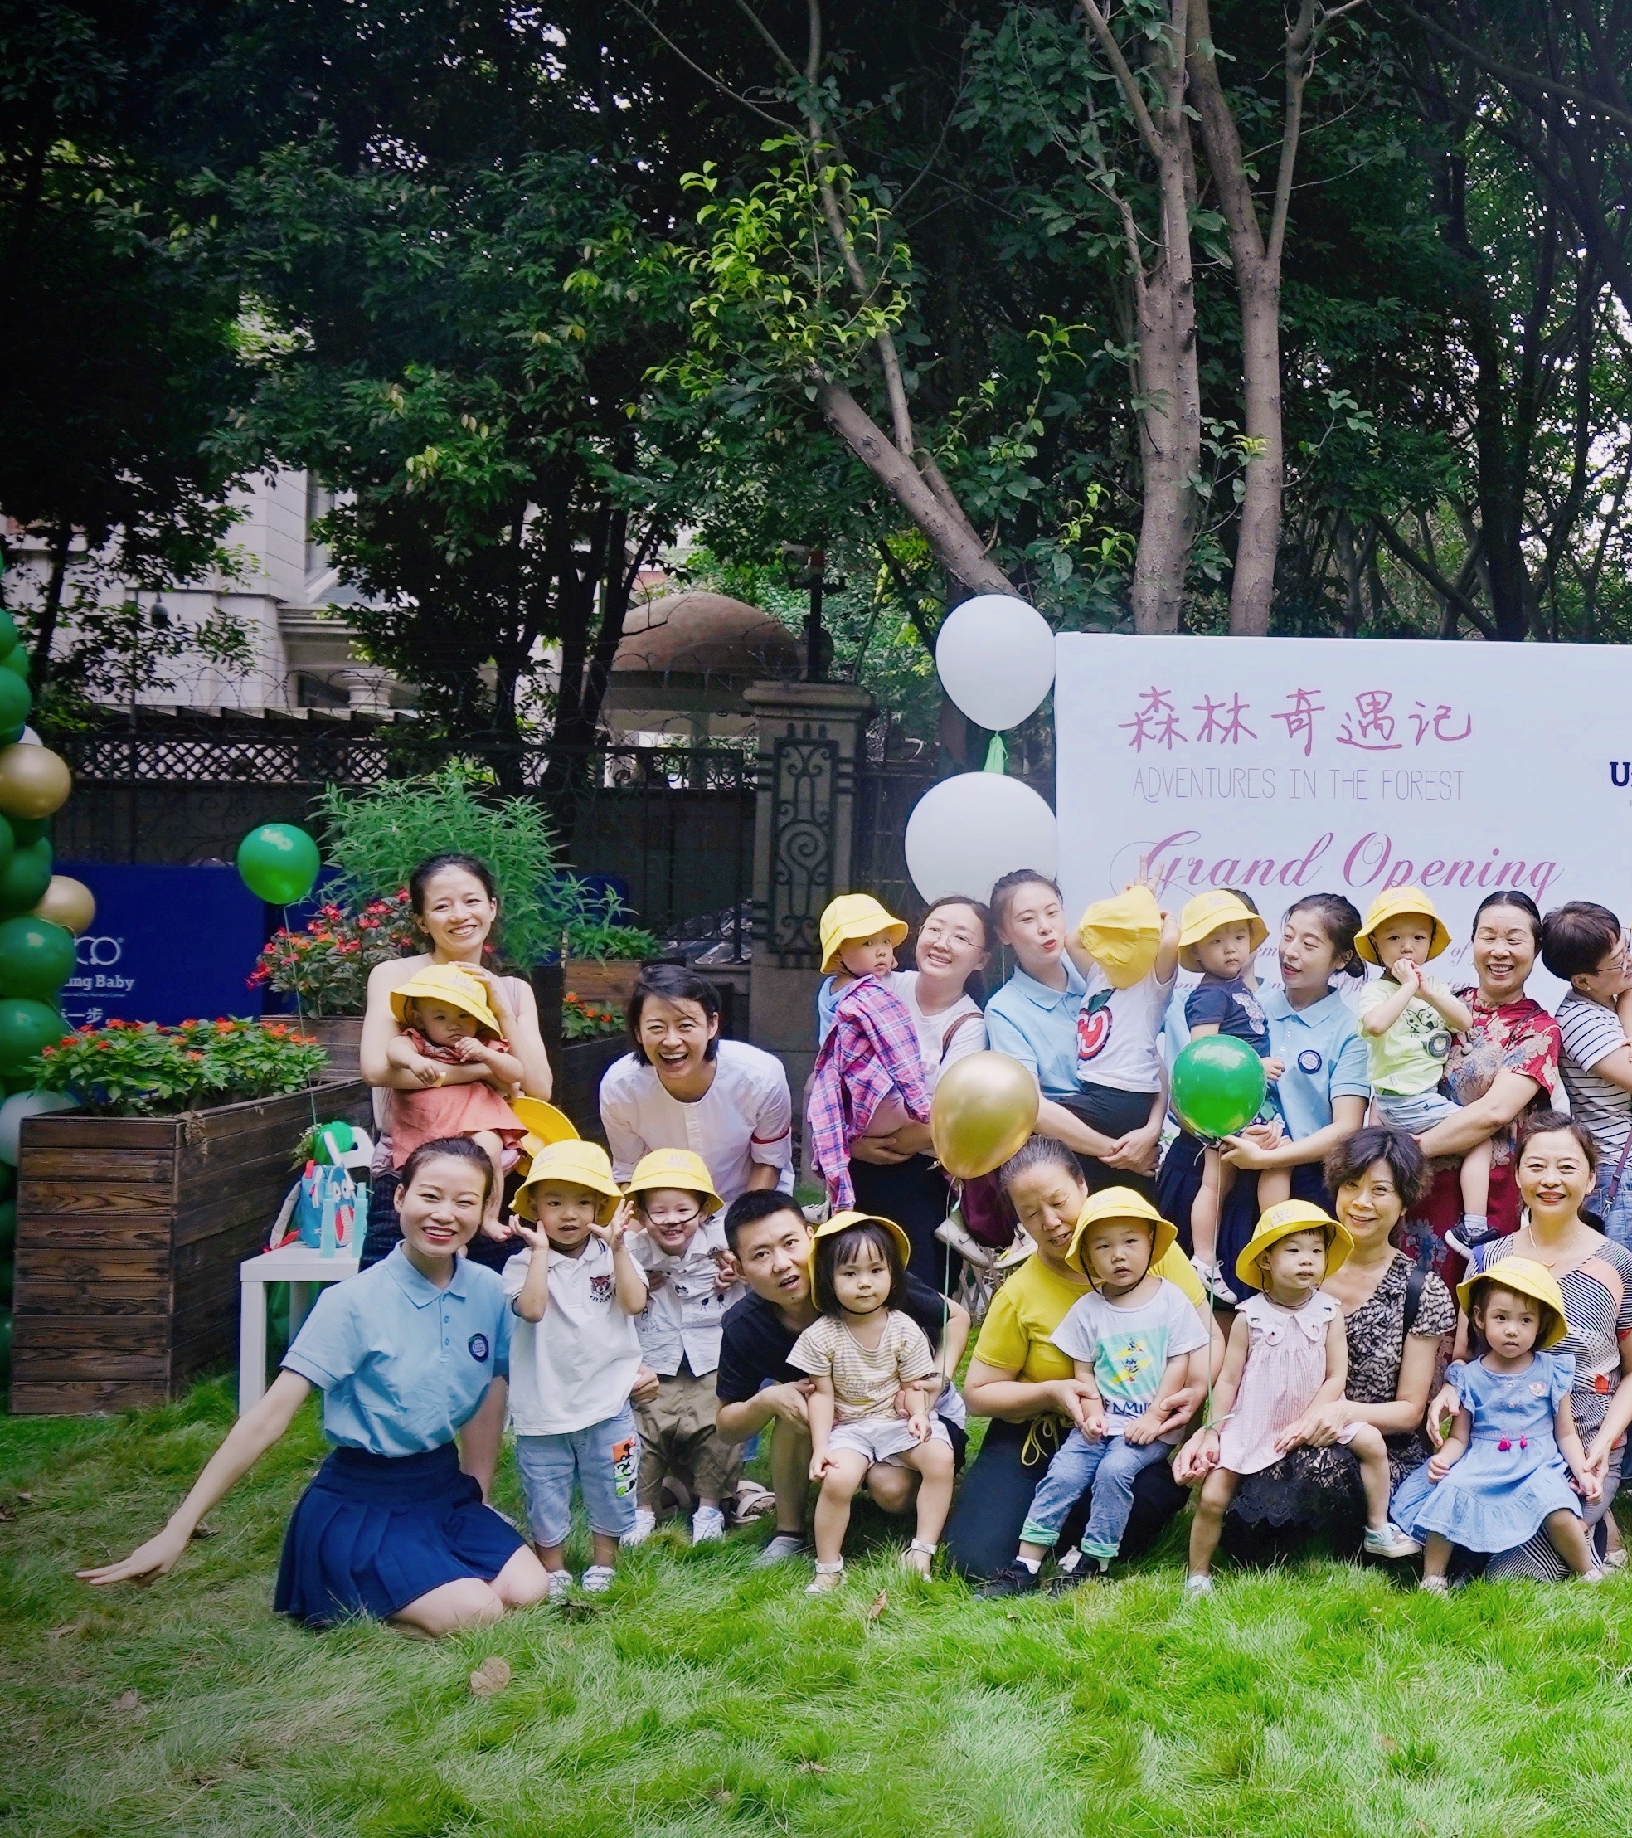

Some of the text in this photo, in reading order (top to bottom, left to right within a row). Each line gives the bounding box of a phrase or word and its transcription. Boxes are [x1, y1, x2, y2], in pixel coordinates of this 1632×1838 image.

[1118, 686, 1473, 756] 森林奇遇记
[1132, 766, 1466, 803] ADVENTURES IN THE FOREST
[1110, 830, 1565, 903] Grand Opening
[95, 974, 135, 991] Baby
